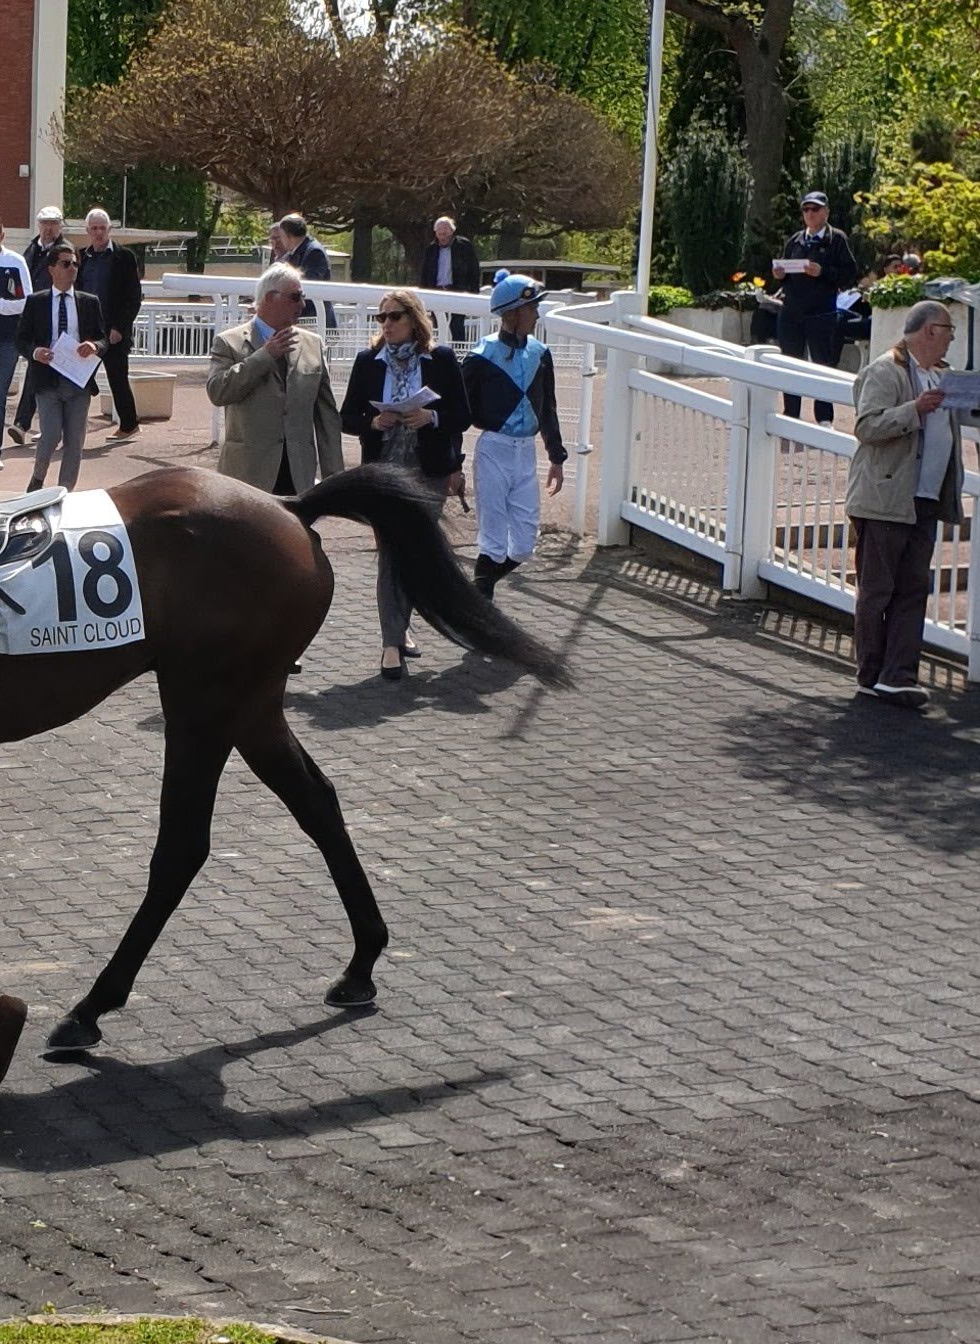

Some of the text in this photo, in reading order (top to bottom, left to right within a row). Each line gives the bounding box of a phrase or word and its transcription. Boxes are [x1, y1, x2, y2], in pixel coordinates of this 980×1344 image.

[31, 531, 133, 622] 18
[30, 617, 142, 647] SAINT CLOUD
